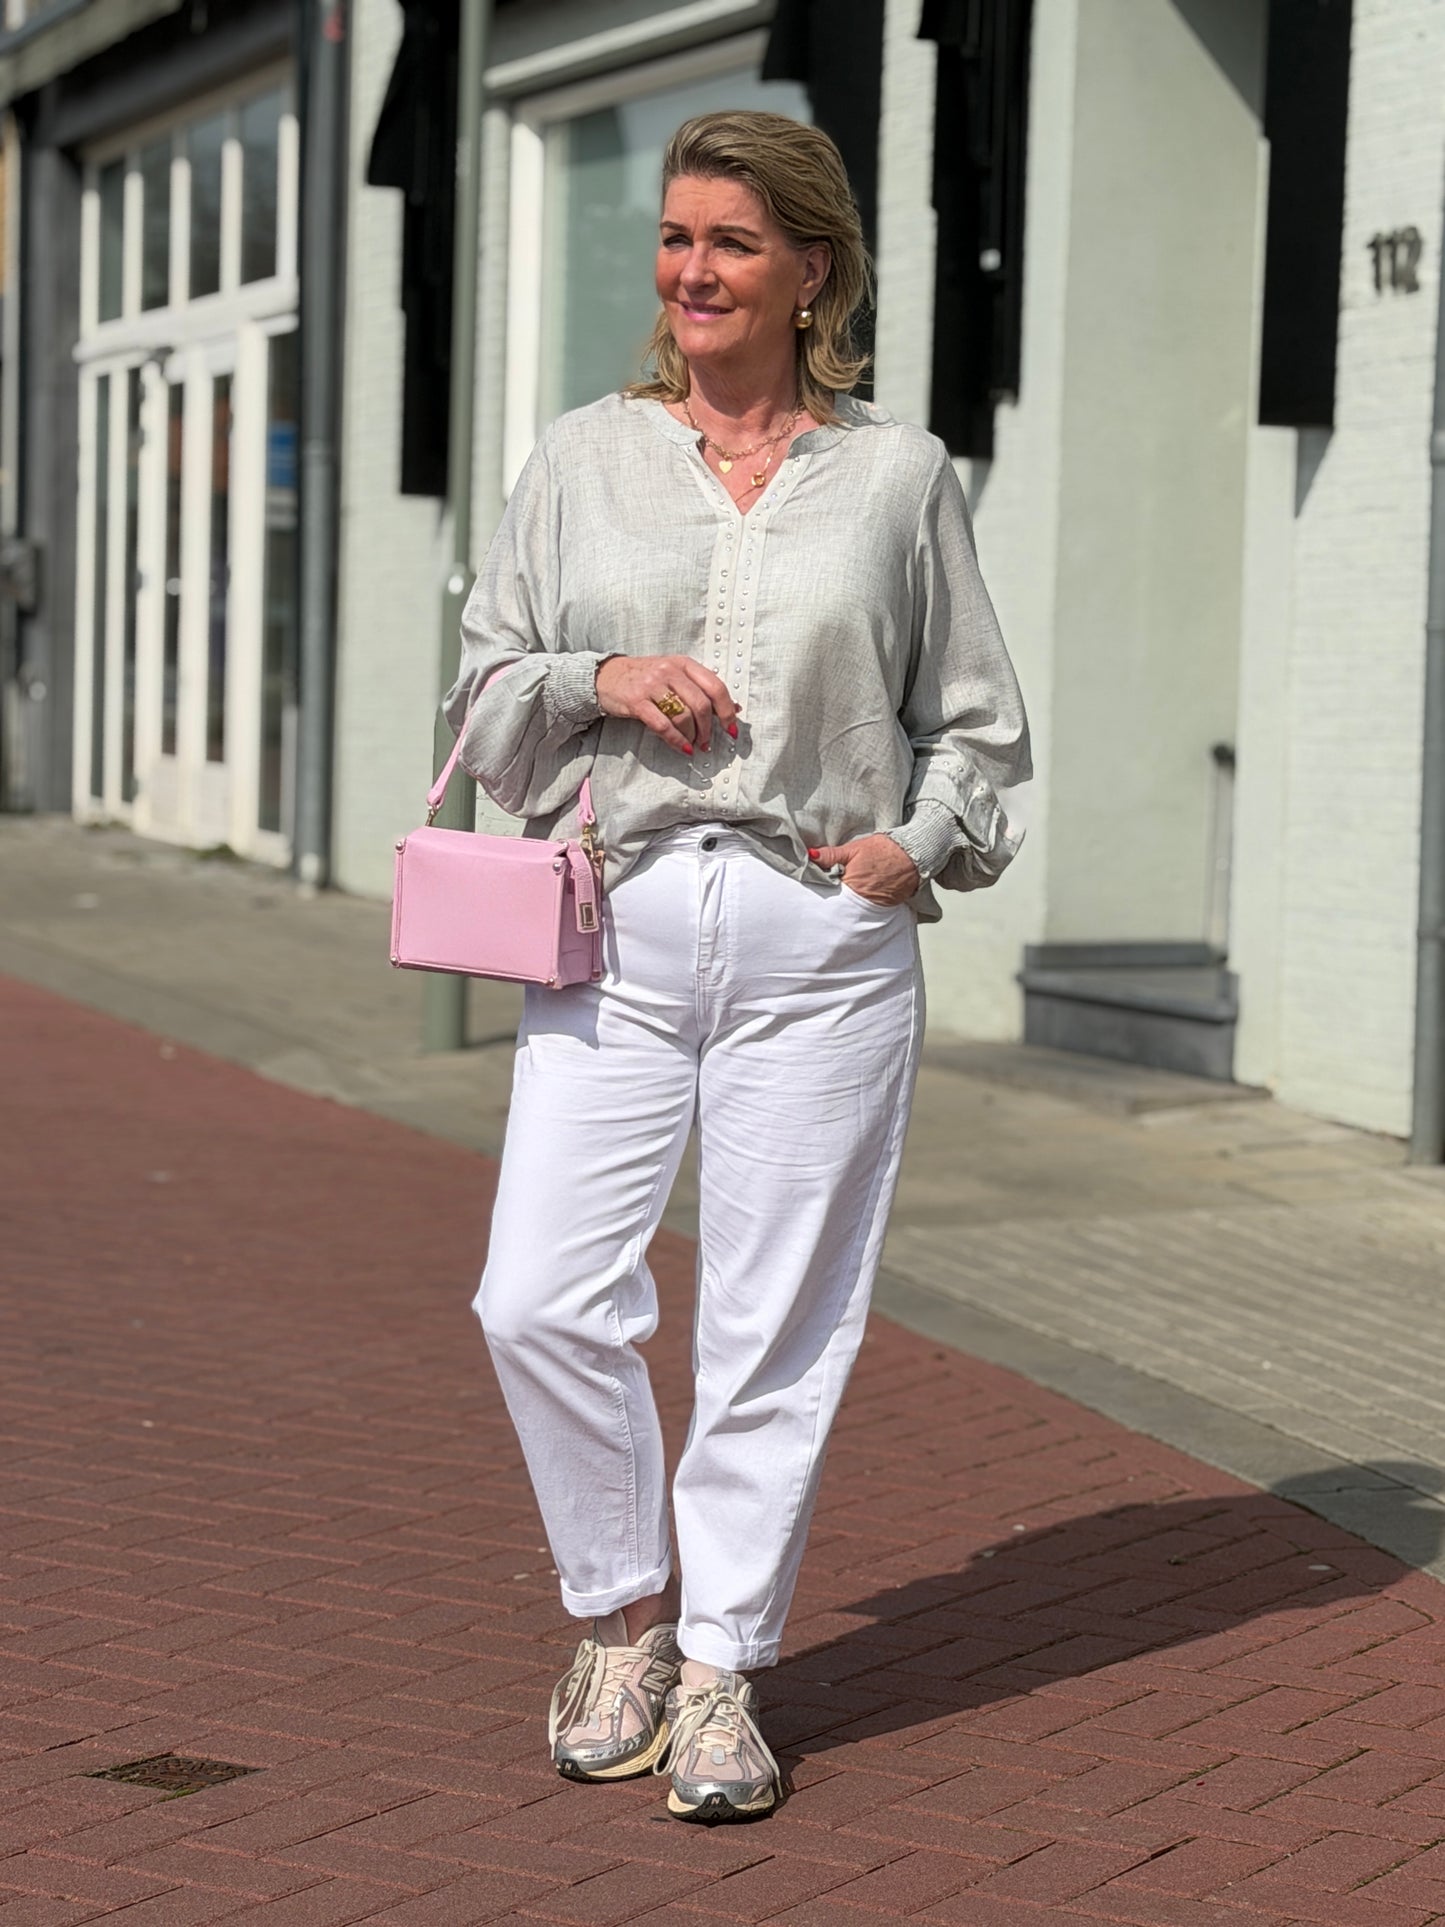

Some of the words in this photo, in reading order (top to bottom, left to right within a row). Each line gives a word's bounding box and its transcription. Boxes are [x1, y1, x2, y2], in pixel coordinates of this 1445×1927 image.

[1365, 226, 1422, 295] 112
[565, 1761, 572, 1771] N
[711, 1796, 720, 1805] N
